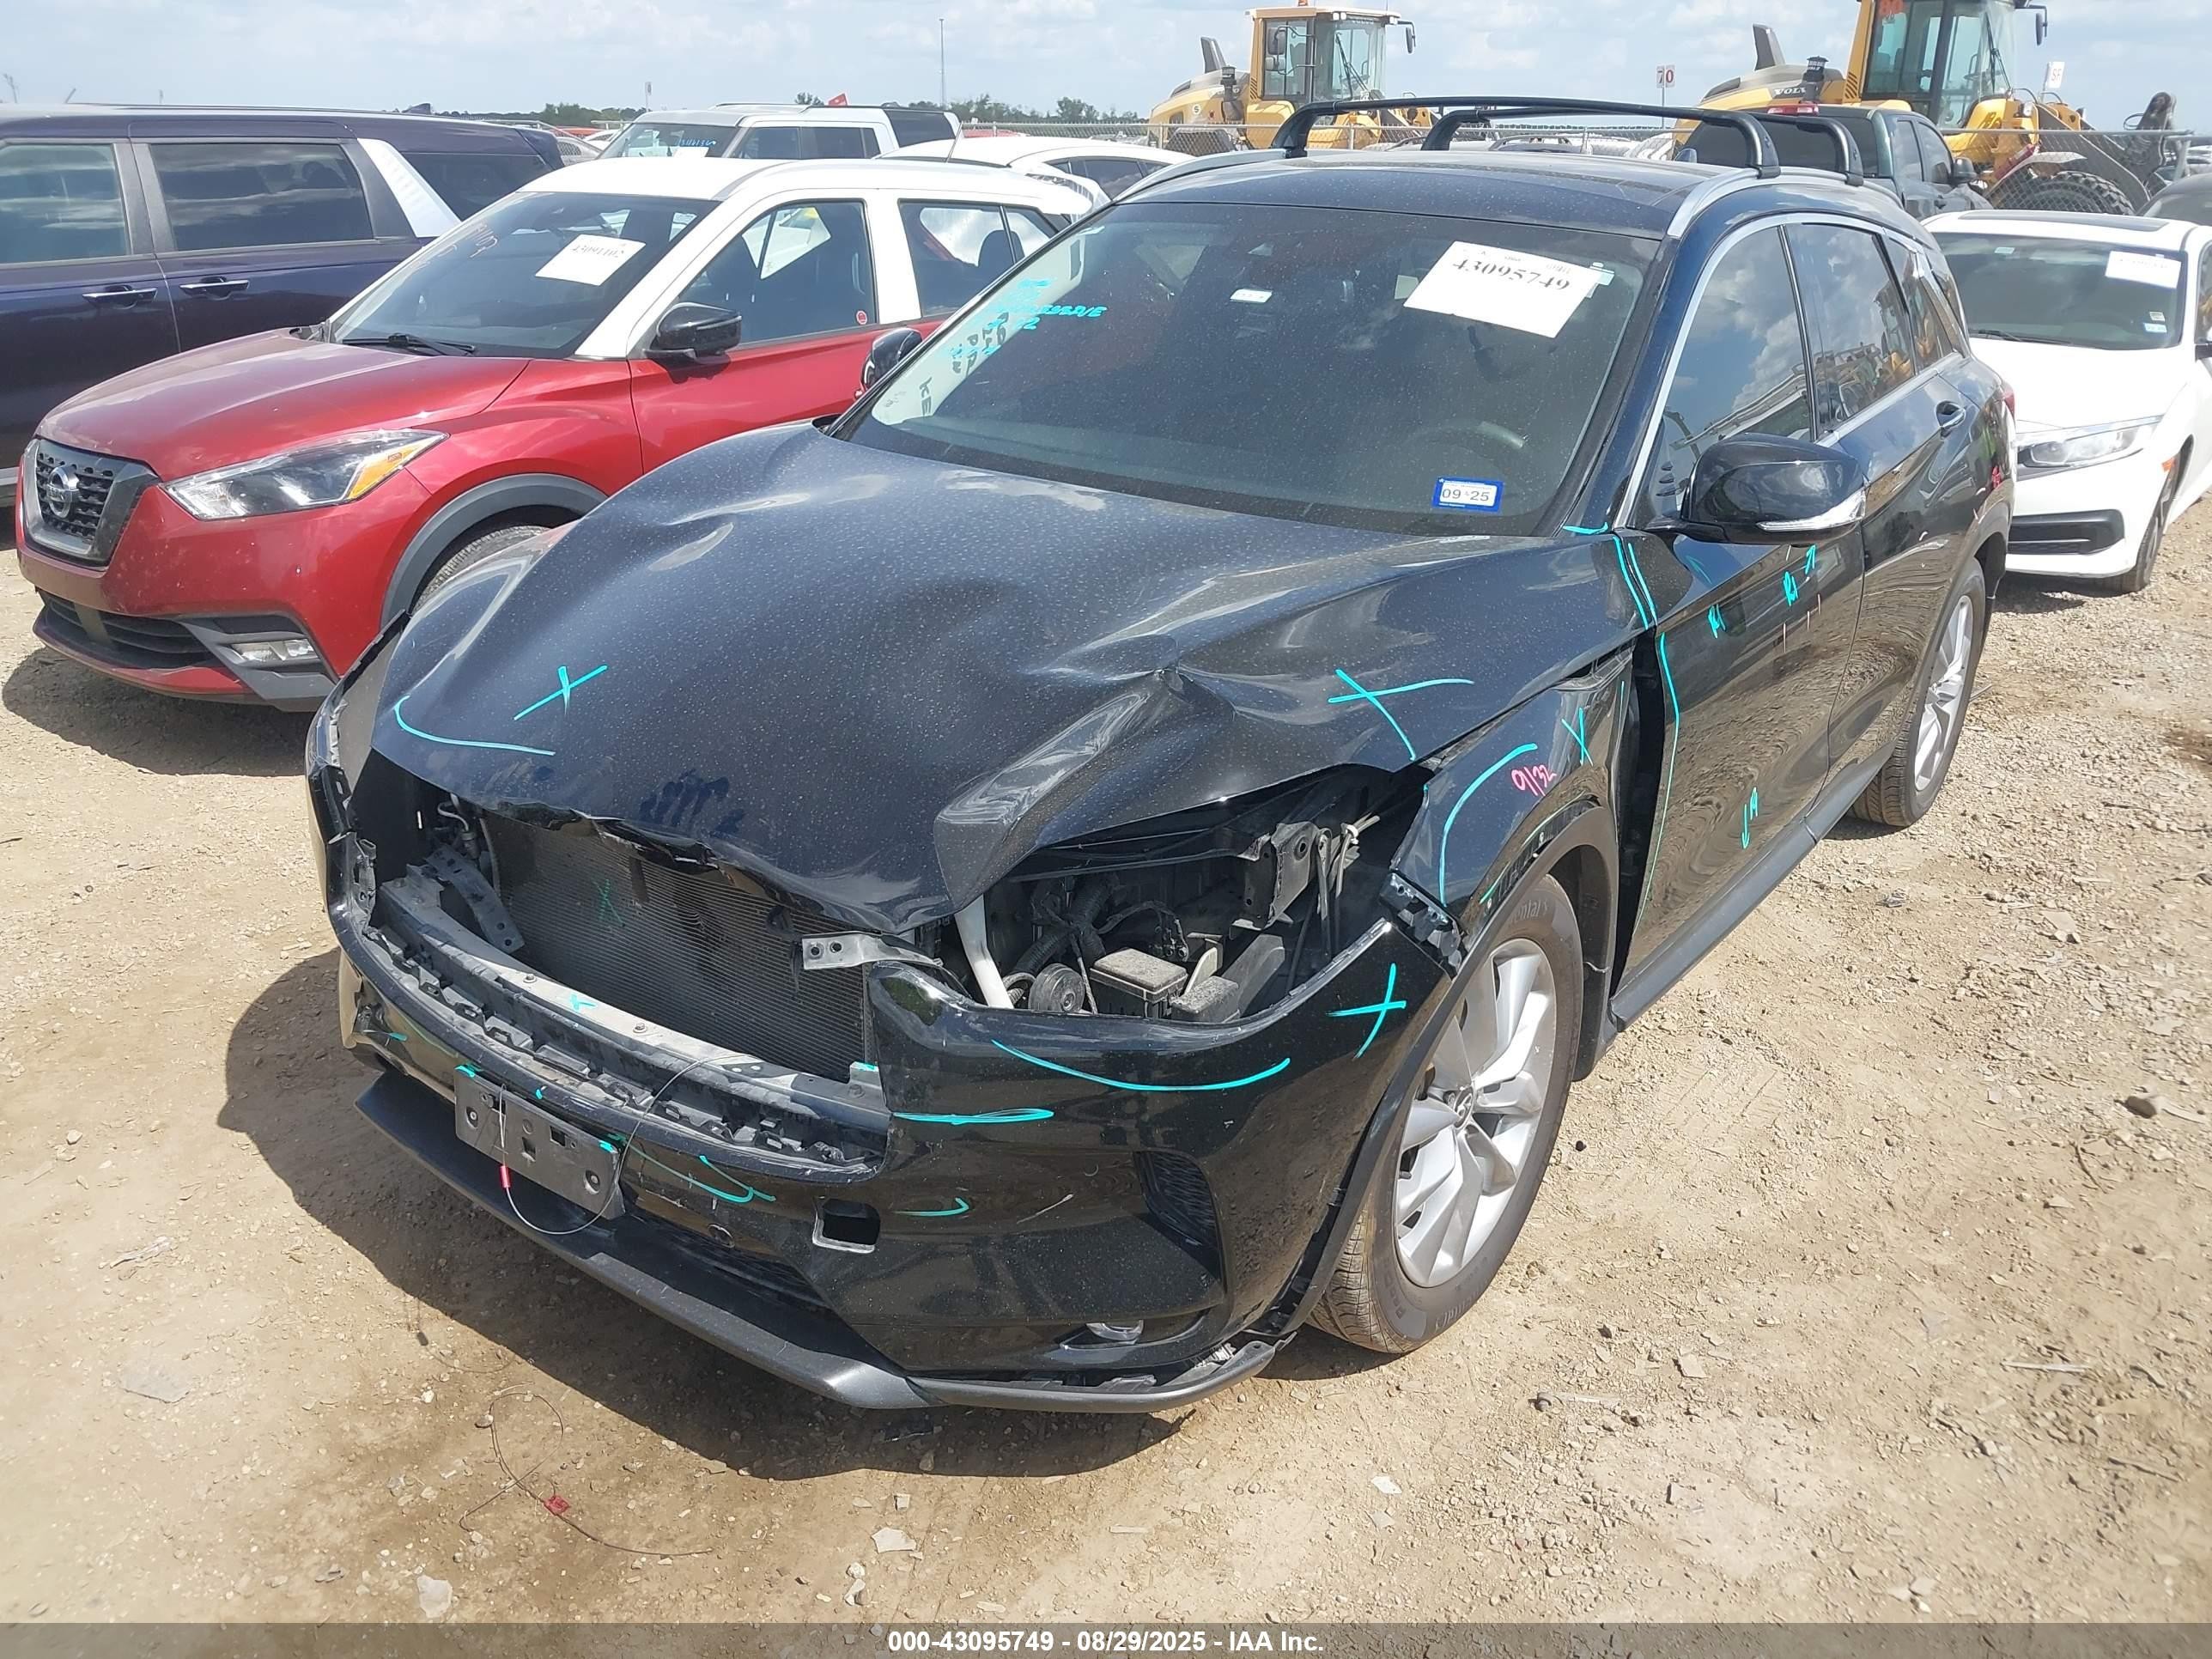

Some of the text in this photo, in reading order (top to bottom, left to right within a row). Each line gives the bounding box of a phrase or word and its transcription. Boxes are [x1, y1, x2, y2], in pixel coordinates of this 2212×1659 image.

[1657, 69, 1674, 84] 70
[1452, 258, 1571, 290] 43095749
[1442, 488, 1491, 502] 09 25
